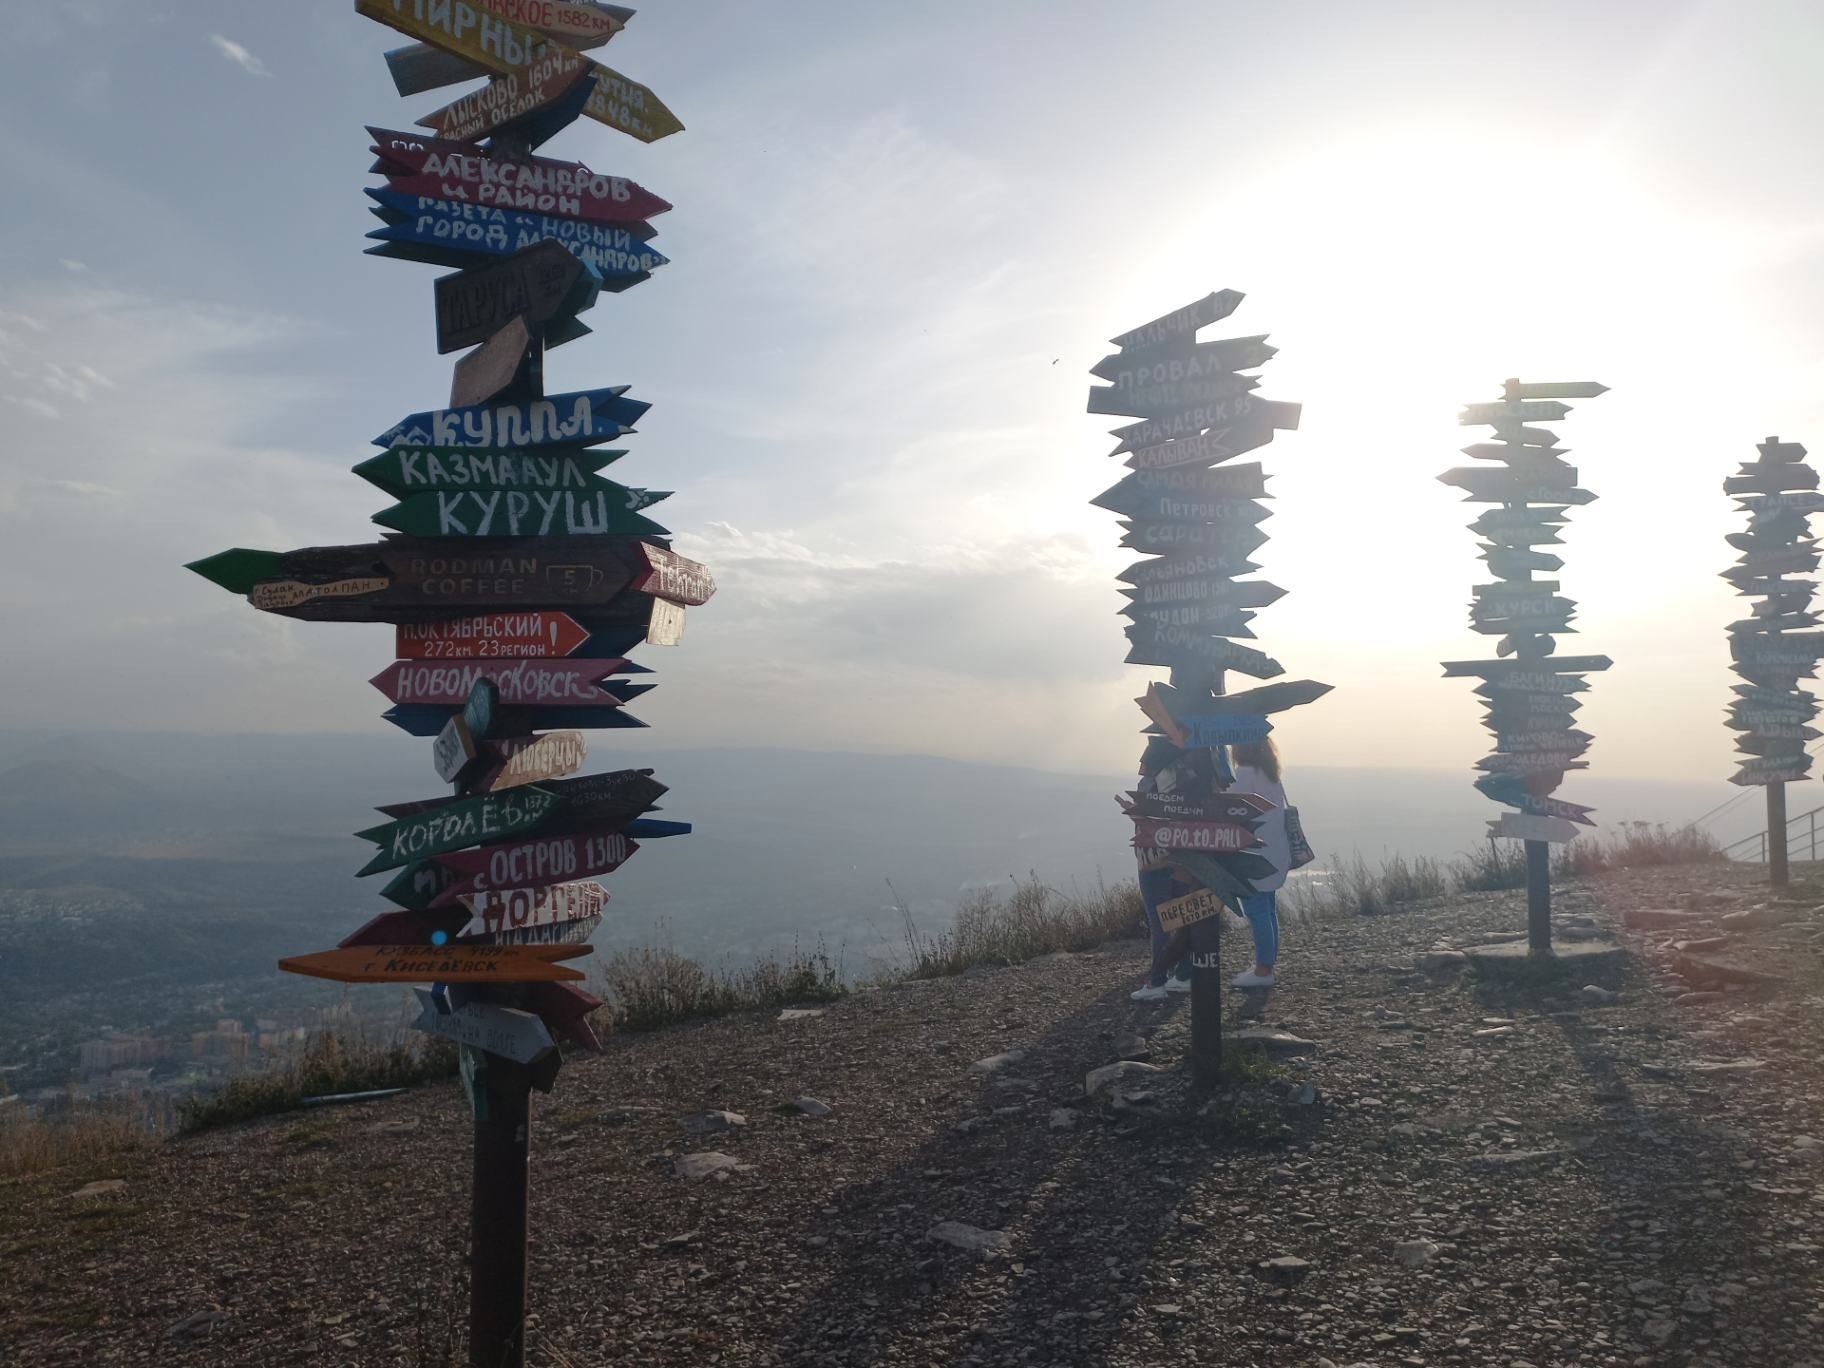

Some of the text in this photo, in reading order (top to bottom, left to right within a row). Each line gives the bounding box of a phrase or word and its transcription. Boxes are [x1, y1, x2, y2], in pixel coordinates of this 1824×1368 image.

[443, 74, 519, 130] ЛЫСКОВО
[528, 52, 562, 88] 1604
[421, 152, 632, 202] АЛЕКСАНДРОВ
[478, 183, 581, 217] РАЙОН
[416, 216, 509, 252] ГОРОД
[1118, 353, 1222, 391] ПРОВАЛ
[433, 396, 594, 448] КУППА
[398, 451, 588, 488] КАЗМААУЛ
[438, 490, 609, 536] КУРУШ
[409, 558, 539, 577] RODMAN
[421, 578, 526, 595] COFFEE
[424, 640, 455, 657] 272
[397, 660, 601, 700] НОВОМСКОВСК
[390, 791, 523, 861] КОРОЛЁВ
[490, 840, 577, 883] ОСТРОВ
[584, 832, 627, 869] 1300
[1160, 892, 1214, 921] ПЕРЕСВЕТ
